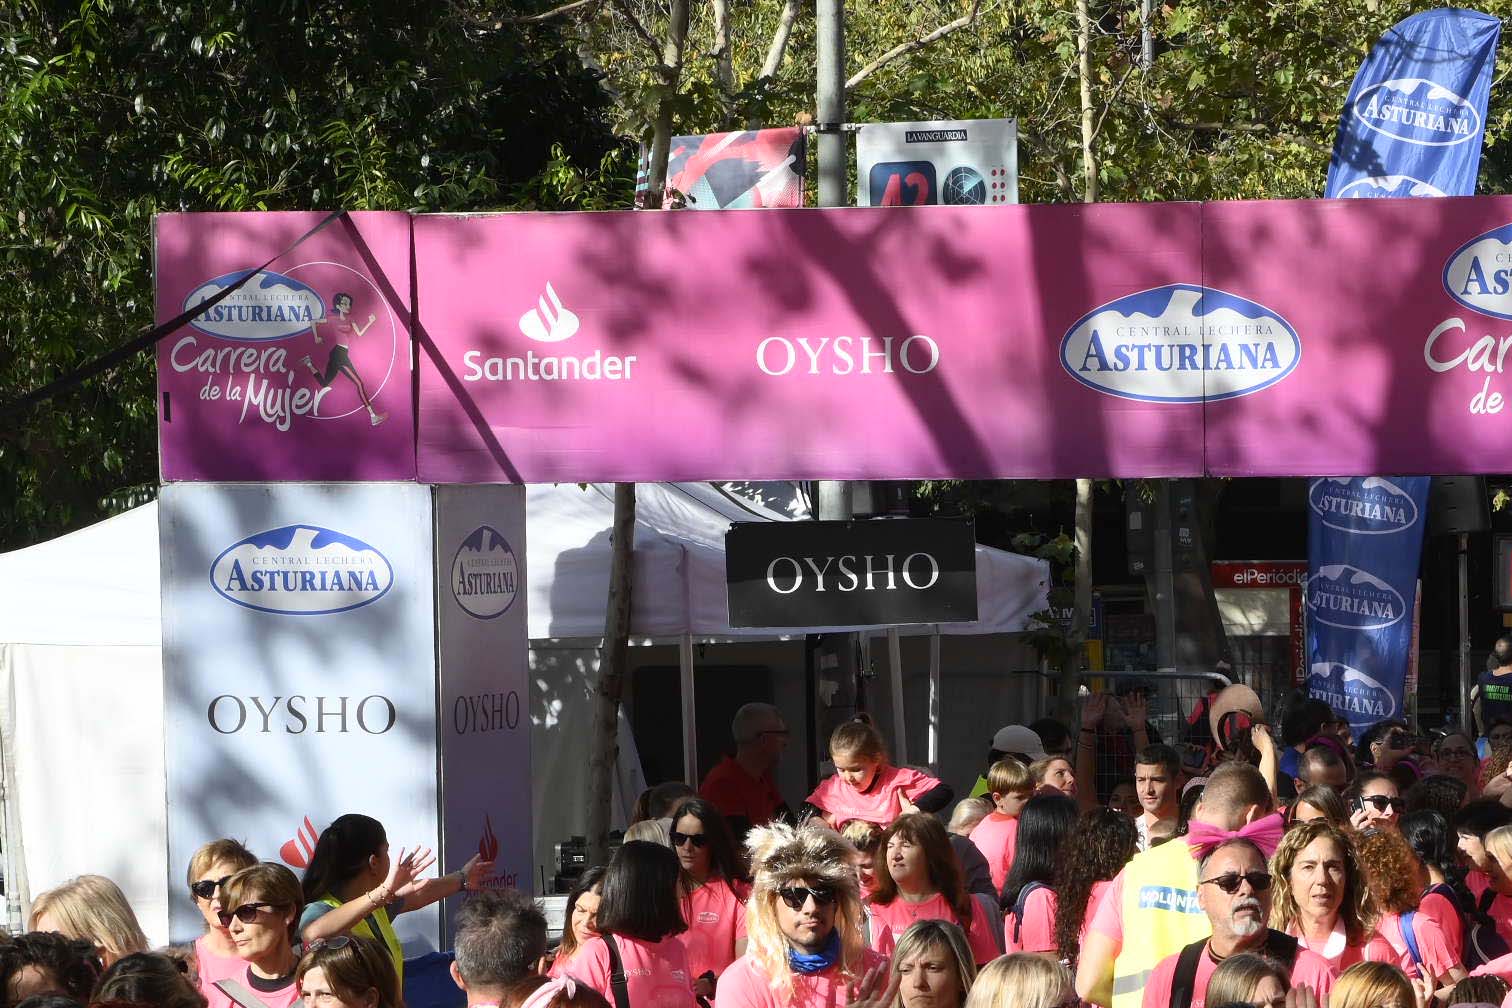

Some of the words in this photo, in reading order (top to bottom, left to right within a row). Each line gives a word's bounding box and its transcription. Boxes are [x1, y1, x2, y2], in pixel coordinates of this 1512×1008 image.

[1362, 94, 1469, 135] ASTURIANA
[1079, 329, 1281, 372] ASTURIANA
[1116, 326, 1191, 337] CENTRAL
[1199, 325, 1273, 336] LECHERA
[170, 336, 287, 373] Carrera
[464, 350, 637, 382] Santander
[756, 334, 939, 375] OYSHO
[200, 375, 221, 400] de
[226, 375, 242, 401] la
[239, 370, 332, 431] Mujer
[1470, 376, 1505, 415] de
[225, 558, 380, 592] ASTURIANA
[252, 556, 308, 565] CENTRAL
[456, 560, 515, 596] ASTURIANA
[767, 552, 940, 597] OYSHO
[207, 694, 397, 735] OYSHO
[455, 690, 520, 735] OYSHO
[1309, 687, 1385, 717] STURIANA
